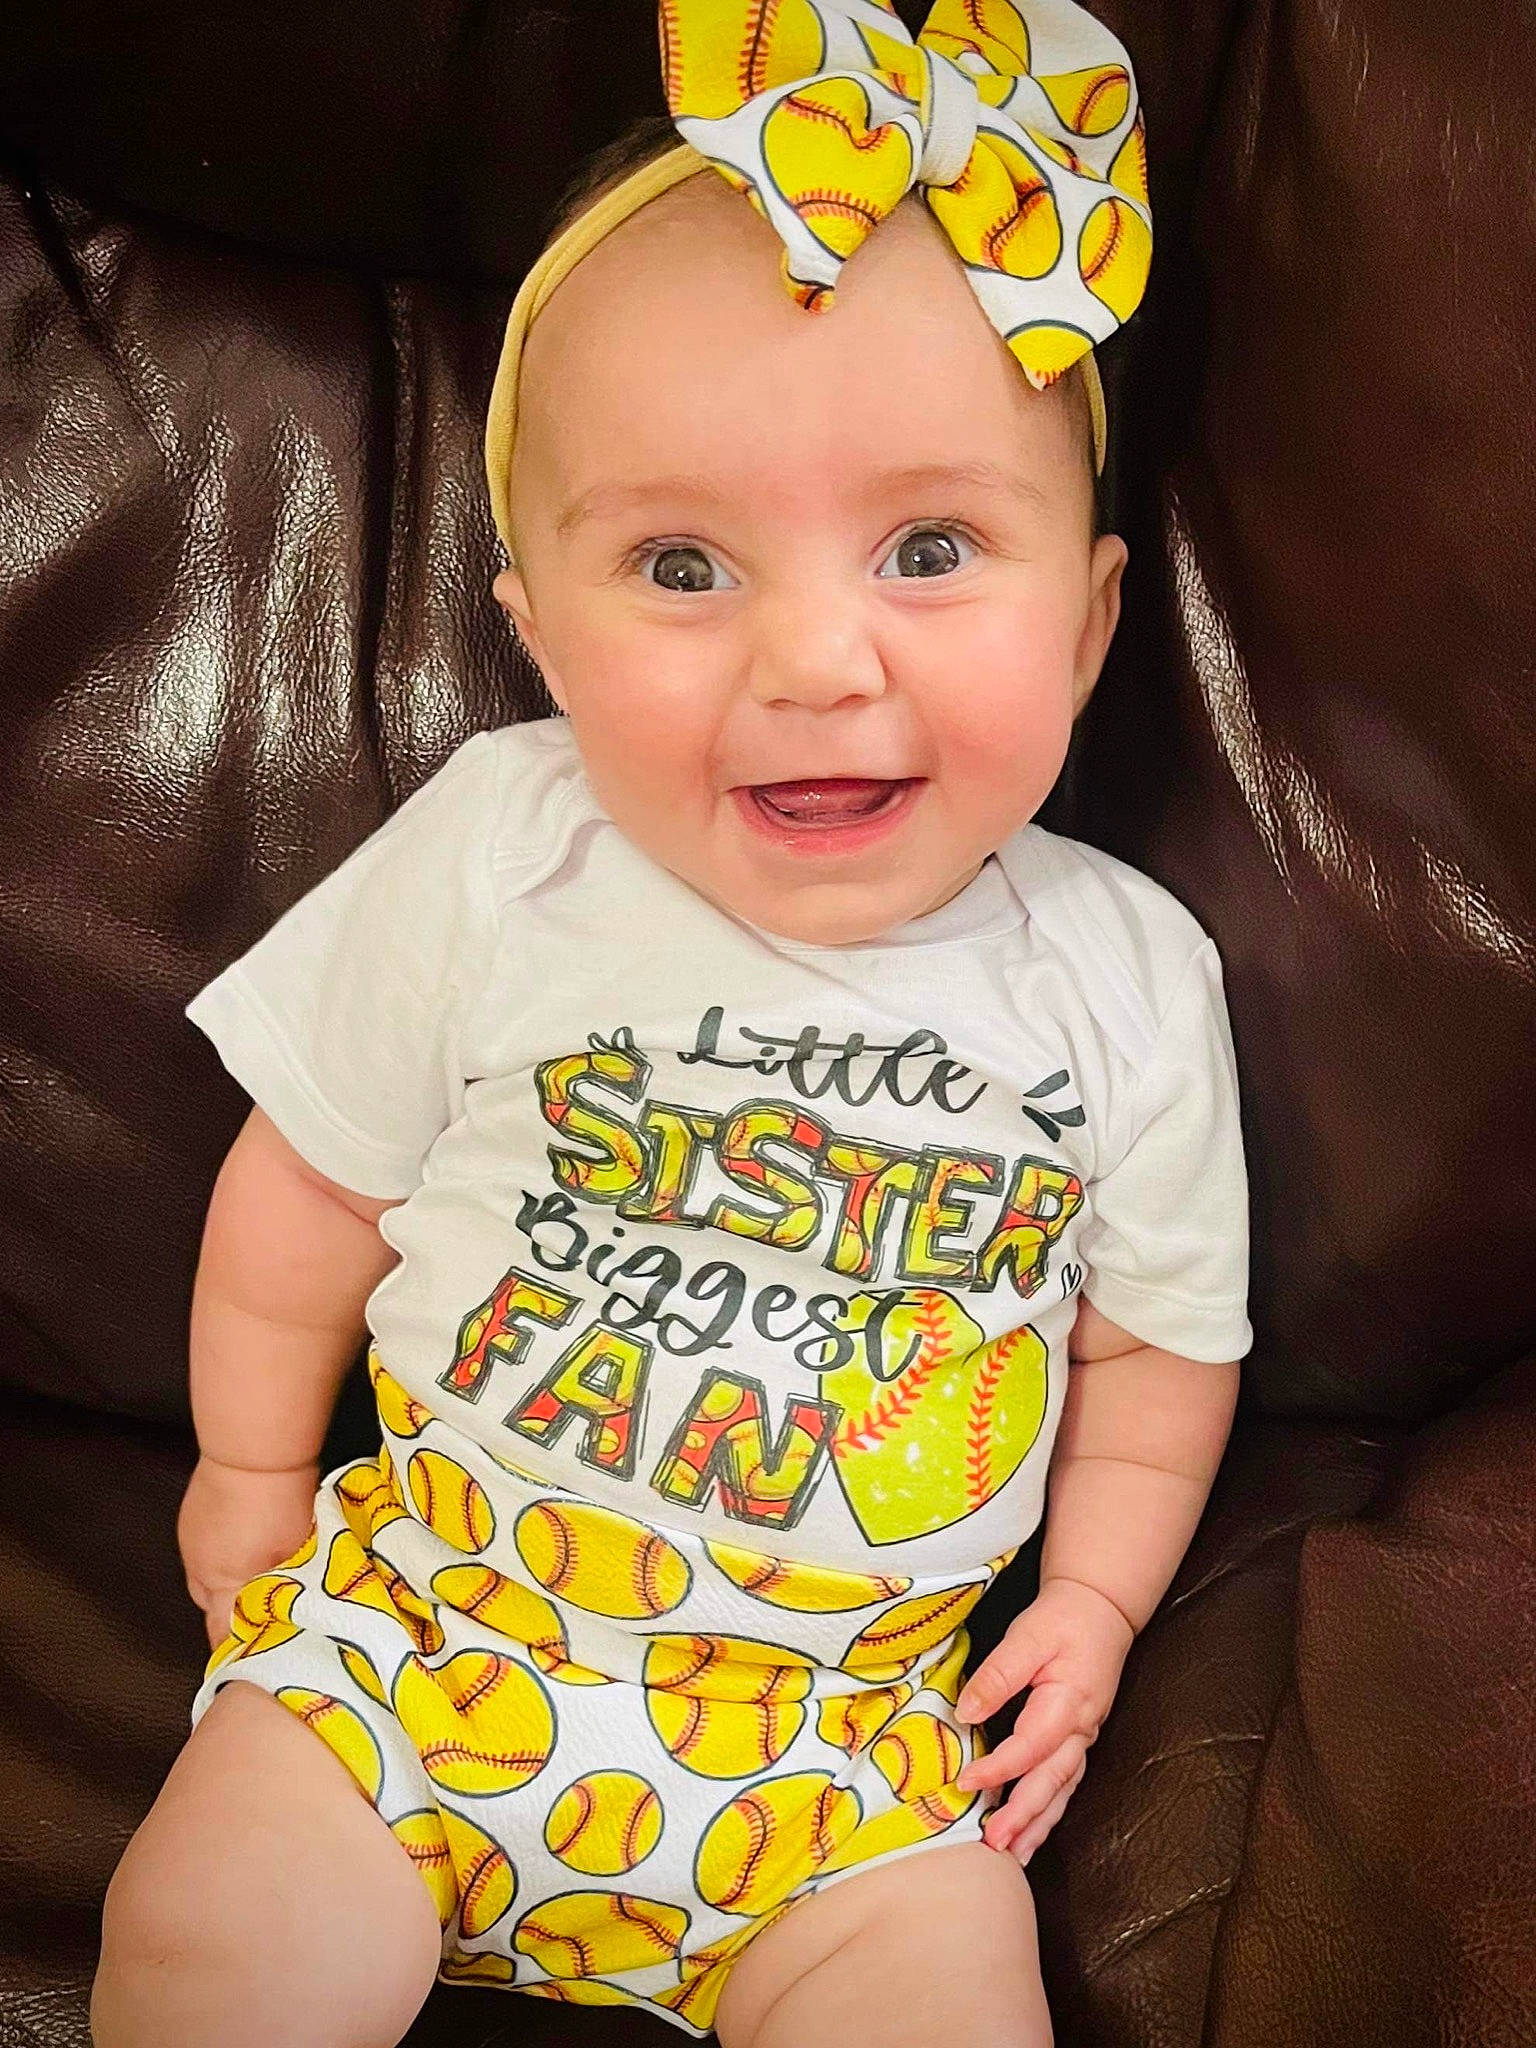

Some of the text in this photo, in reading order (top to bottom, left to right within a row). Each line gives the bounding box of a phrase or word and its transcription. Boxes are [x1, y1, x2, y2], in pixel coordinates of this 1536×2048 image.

[677, 1006, 989, 1113] Little
[534, 1050, 1084, 1298] SISTER
[516, 1189, 923, 1381] Biggest
[436, 1265, 845, 1531] FAN
